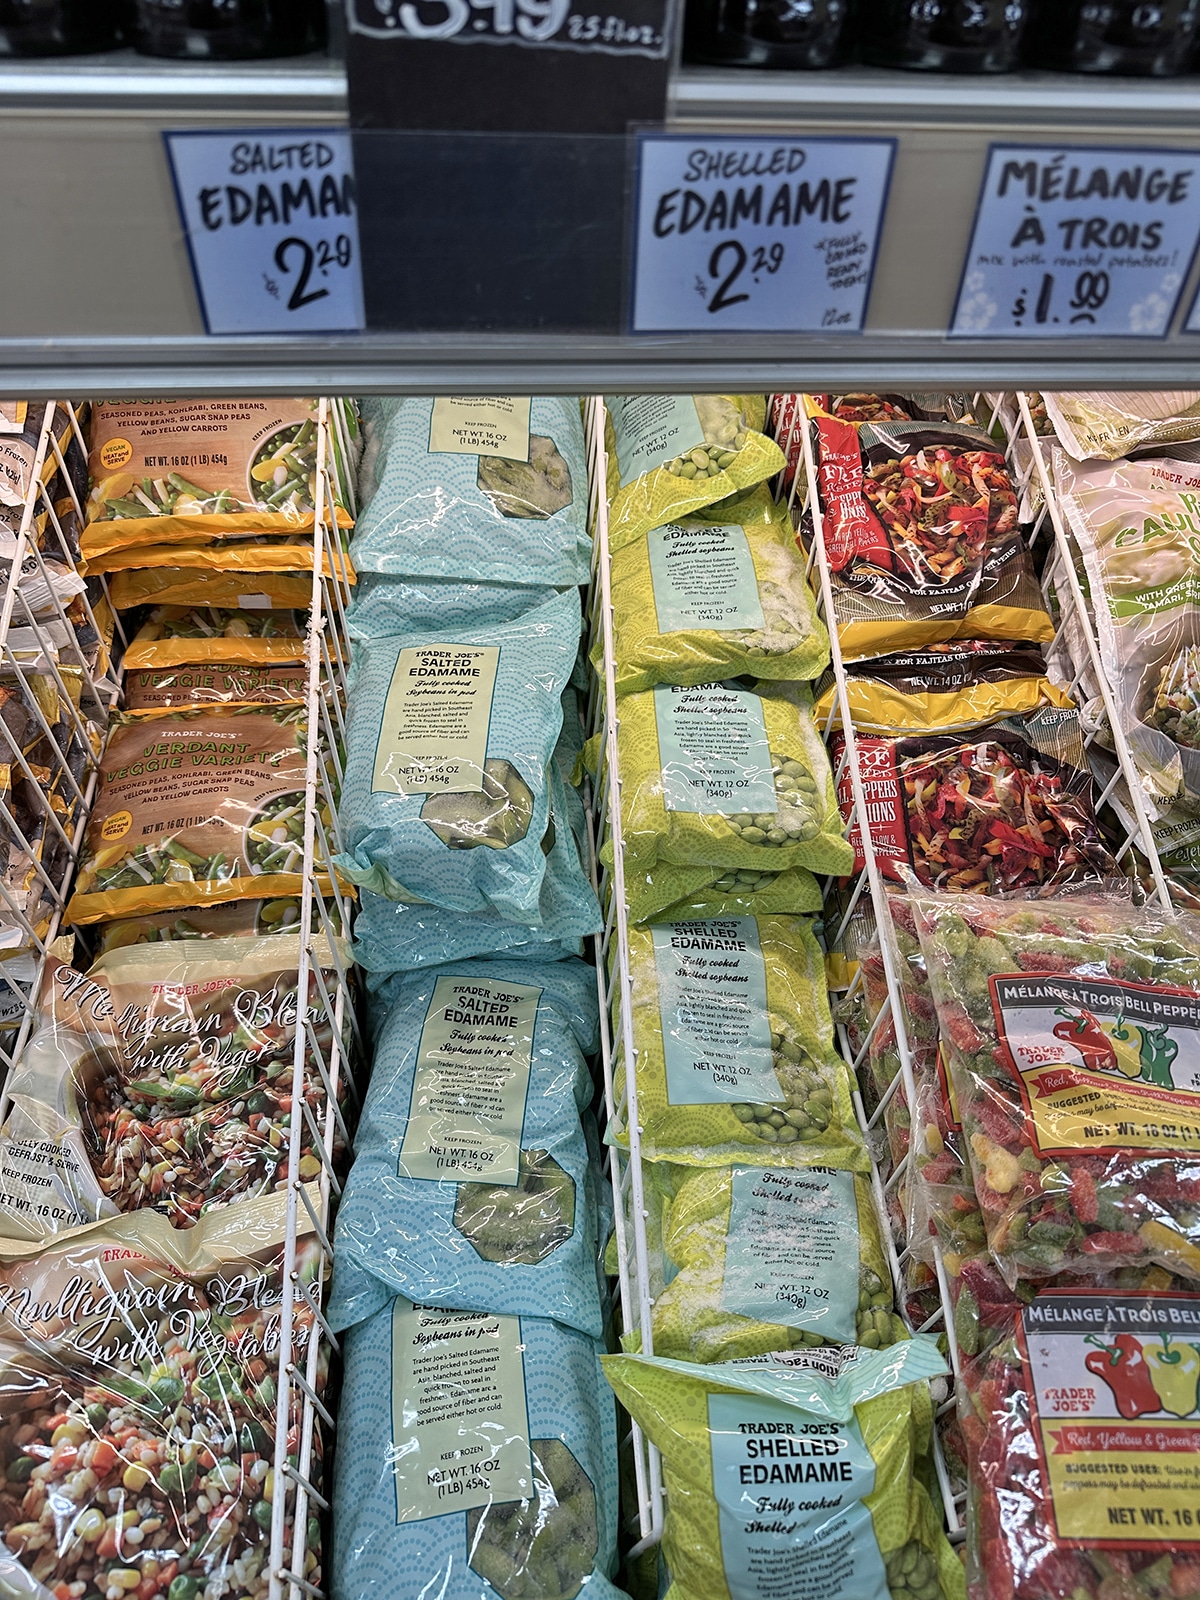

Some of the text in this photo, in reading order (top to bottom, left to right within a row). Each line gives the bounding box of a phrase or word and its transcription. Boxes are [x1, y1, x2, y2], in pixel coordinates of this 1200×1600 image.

[230, 143, 333, 176] SALTED
[684, 147, 807, 182] SHELLED
[997, 154, 1194, 205] MÉLANGE
[198, 175, 354, 231] EDAMA
[653, 177, 858, 239] EDAMAME
[1010, 205, 1165, 251] À TROIS
[101, 401, 267, 421] SEASONED PEAS, KOHLRABI, GREEN BEANS,
[117, 411, 251, 428] YELLOW BEANS, SUGAR SNAP PEAS
[477, 422, 498, 431] FROZEN
[140, 423, 229, 436] AND YELLOW CARROTS
[452, 429, 508, 442] NET 16 OZ
[105, 444, 126, 453] VEGAN
[481, 440, 499, 449] 454g
[4, 446, 28, 468] Frozen
[102, 452, 118, 461] HEAT
[106, 457, 126, 467] SERVE
[144, 453, 229, 468] NET WT. 16 OZ LB) 454g
[1151, 466, 1183, 485] TRADER
[672, 540, 697, 549] Fully
[665, 548, 698, 560] Shelled
[928, 584, 966, 599] FAJITAS
[1135, 589, 1164, 604] WITH
[1142, 592, 1184, 611] TAMARI,
[415, 650, 452, 659] TRADER
[895, 652, 953, 668] FOR FAJITAS
[421, 658, 472, 668] SALTED
[408, 668, 481, 678] EDAMAME
[950, 675, 962, 686] OZ
[139, 674, 216, 689] VEGGIE
[415, 680, 441, 688] Fully
[406, 688, 457, 697] Soybeans in
[1040, 714, 1059, 726] KEEP
[161, 730, 204, 742] TRADER
[143, 741, 252, 758] VERDANT
[106, 751, 285, 783] VEGGIE VARIETY
[399, 766, 460, 776] NET OZ
[109, 768, 273, 796] SEASONED BEANS,
[430, 774, 450, 786] 454g
[725, 780, 750, 788] 12 OZ
[158, 785, 230, 803] YELLOW CARROTS
[706, 789, 733, 799] (340g)
[1153, 817, 1200, 840] KEEP FROZEN
[674, 928, 738, 940] SHELLED
[671, 937, 747, 953] EDAMAME
[682, 955, 741, 970] Fully cooked
[675, 968, 750, 984] Shelled soybeans
[453, 985, 492, 999] TRADER
[1003, 984, 1153, 1015] MÉLANGE TROIS BELL
[457, 996, 510, 1014] SALTED
[444, 1009, 519, 1029] EDAMAME
[450, 1029, 476, 1044] Fully
[129, 1036, 190, 1073] with
[439, 1043, 495, 1057] Soybeans in
[693, 1062, 753, 1077] NET OZ
[713, 1073, 738, 1088] (340g)
[1084, 1121, 1178, 1141] NET WT. OZ
[40, 1142, 72, 1159] COOKED
[428, 1145, 495, 1163] NET WT. 16 OZ
[8, 1146, 80, 1173] DEFROST & SERVE
[2, 1167, 53, 1188] KEEP FROZEN
[15, 1197, 68, 1220] WT. 16 OZ
[775, 1291, 807, 1310] (340g)
[813, 1287, 831, 1303] OZ
[419, 1316, 452, 1329] Fully
[1027, 1304, 1167, 1327] MÉLANGE TROIS
[412, 1329, 463, 1347] Soybeans
[464, 1325, 477, 1338] in
[92, 1324, 165, 1371] with
[413, 1346, 500, 1366] Trader Joe's Salted Edamame
[423, 1354, 501, 1374] hand picked Southeast
[1044, 1387, 1096, 1401] TRADER
[425, 1401, 503, 1427] served either hot cold.
[737, 1423, 796, 1439] TRADER
[746, 1439, 840, 1459] SHELLED
[1067, 1431, 1096, 1449] Red,
[1097, 1430, 1142, 1452] Yellow
[1143, 1432, 1153, 1448] &
[426, 1459, 501, 1487] NET WT. 16 OZ
[739, 1462, 854, 1485] EDAMAME
[1065, 1463, 1128, 1478] SUGGESTED
[437, 1480, 465, 1500] (1 LB)
[755, 1495, 844, 1517] Fully cooked
[1107, 1506, 1193, 1527] NET WT. 16
[744, 1520, 797, 1536] Shelled
